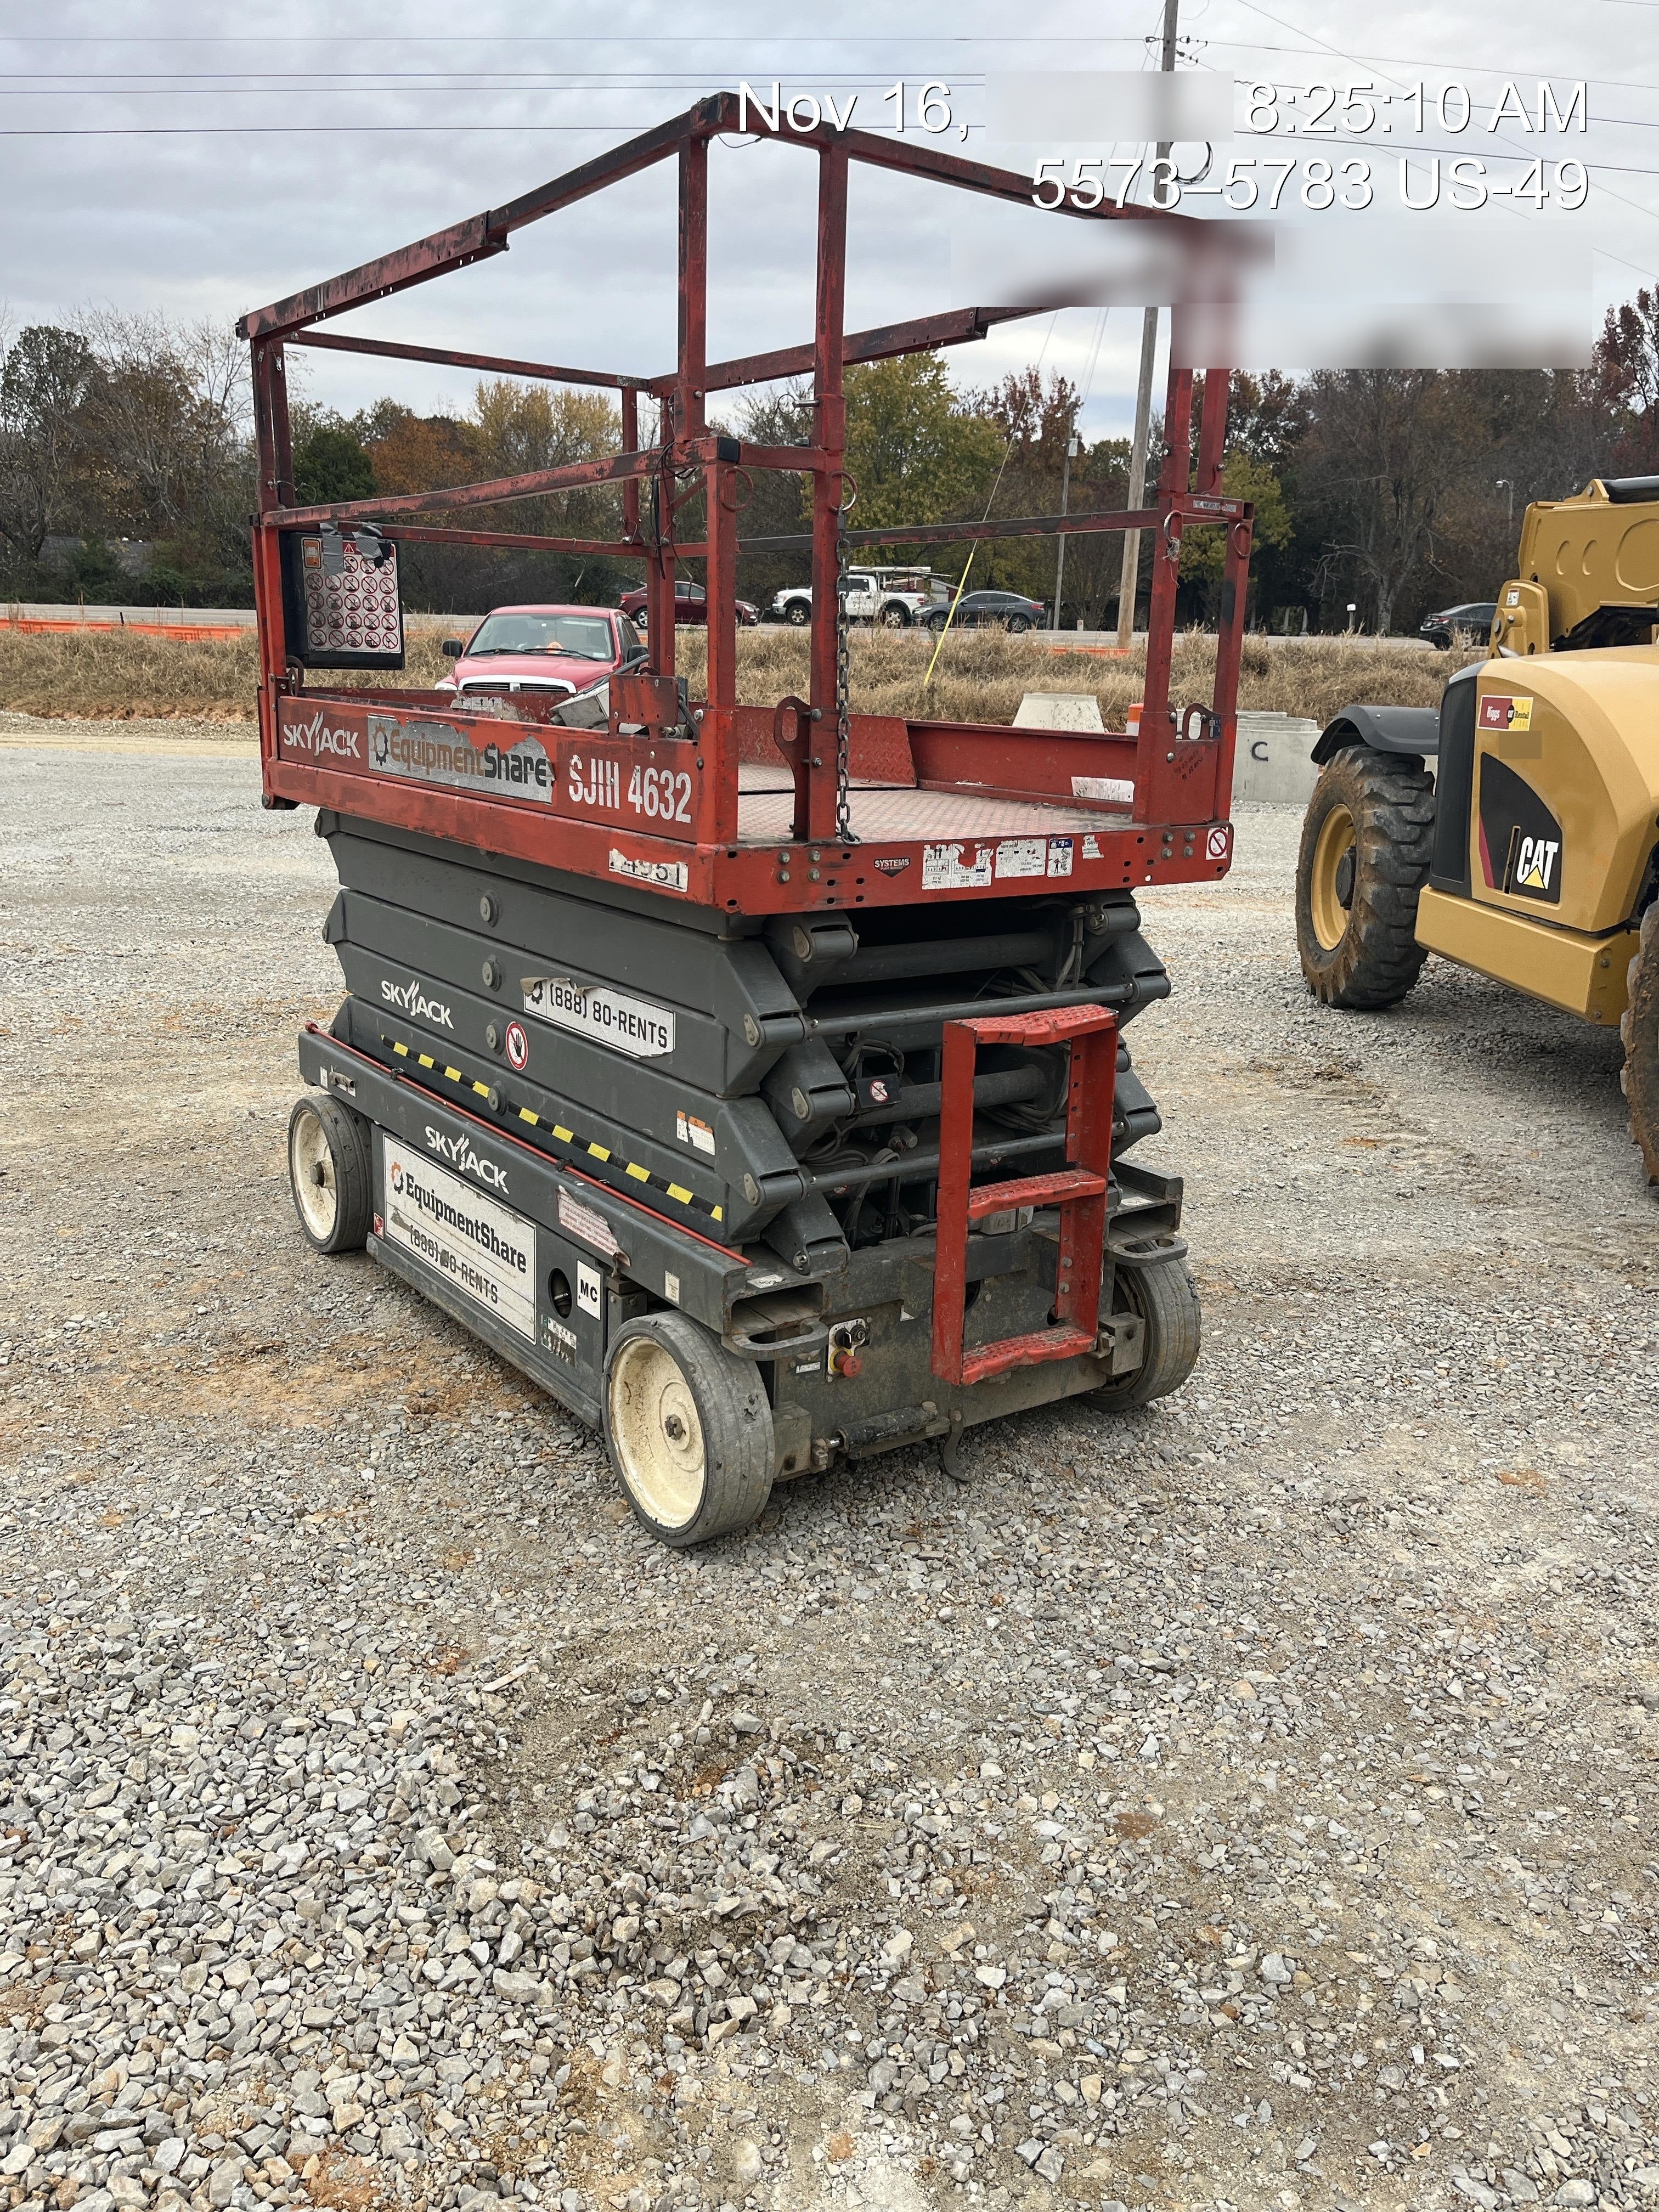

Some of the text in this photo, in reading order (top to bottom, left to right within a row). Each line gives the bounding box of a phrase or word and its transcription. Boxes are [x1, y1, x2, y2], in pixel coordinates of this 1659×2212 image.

[283, 711, 361, 759] SKYJACK
[390, 729, 547, 787] EquipmentShare
[628, 765, 692, 824] 4632
[874, 858, 910, 868] SYSTEMS
[1516, 836, 1559, 890] CAT
[381, 979, 455, 1030] SKYJACK
[550, 983, 668, 1049] (888) 80-RENTS
[425, 1126, 510, 1195] SKYJACK
[406, 1172, 527, 1274] EquipmentShare
[410, 1224, 498, 1305] (888) 0-RENTS
[580, 1278, 598, 1303] MC
